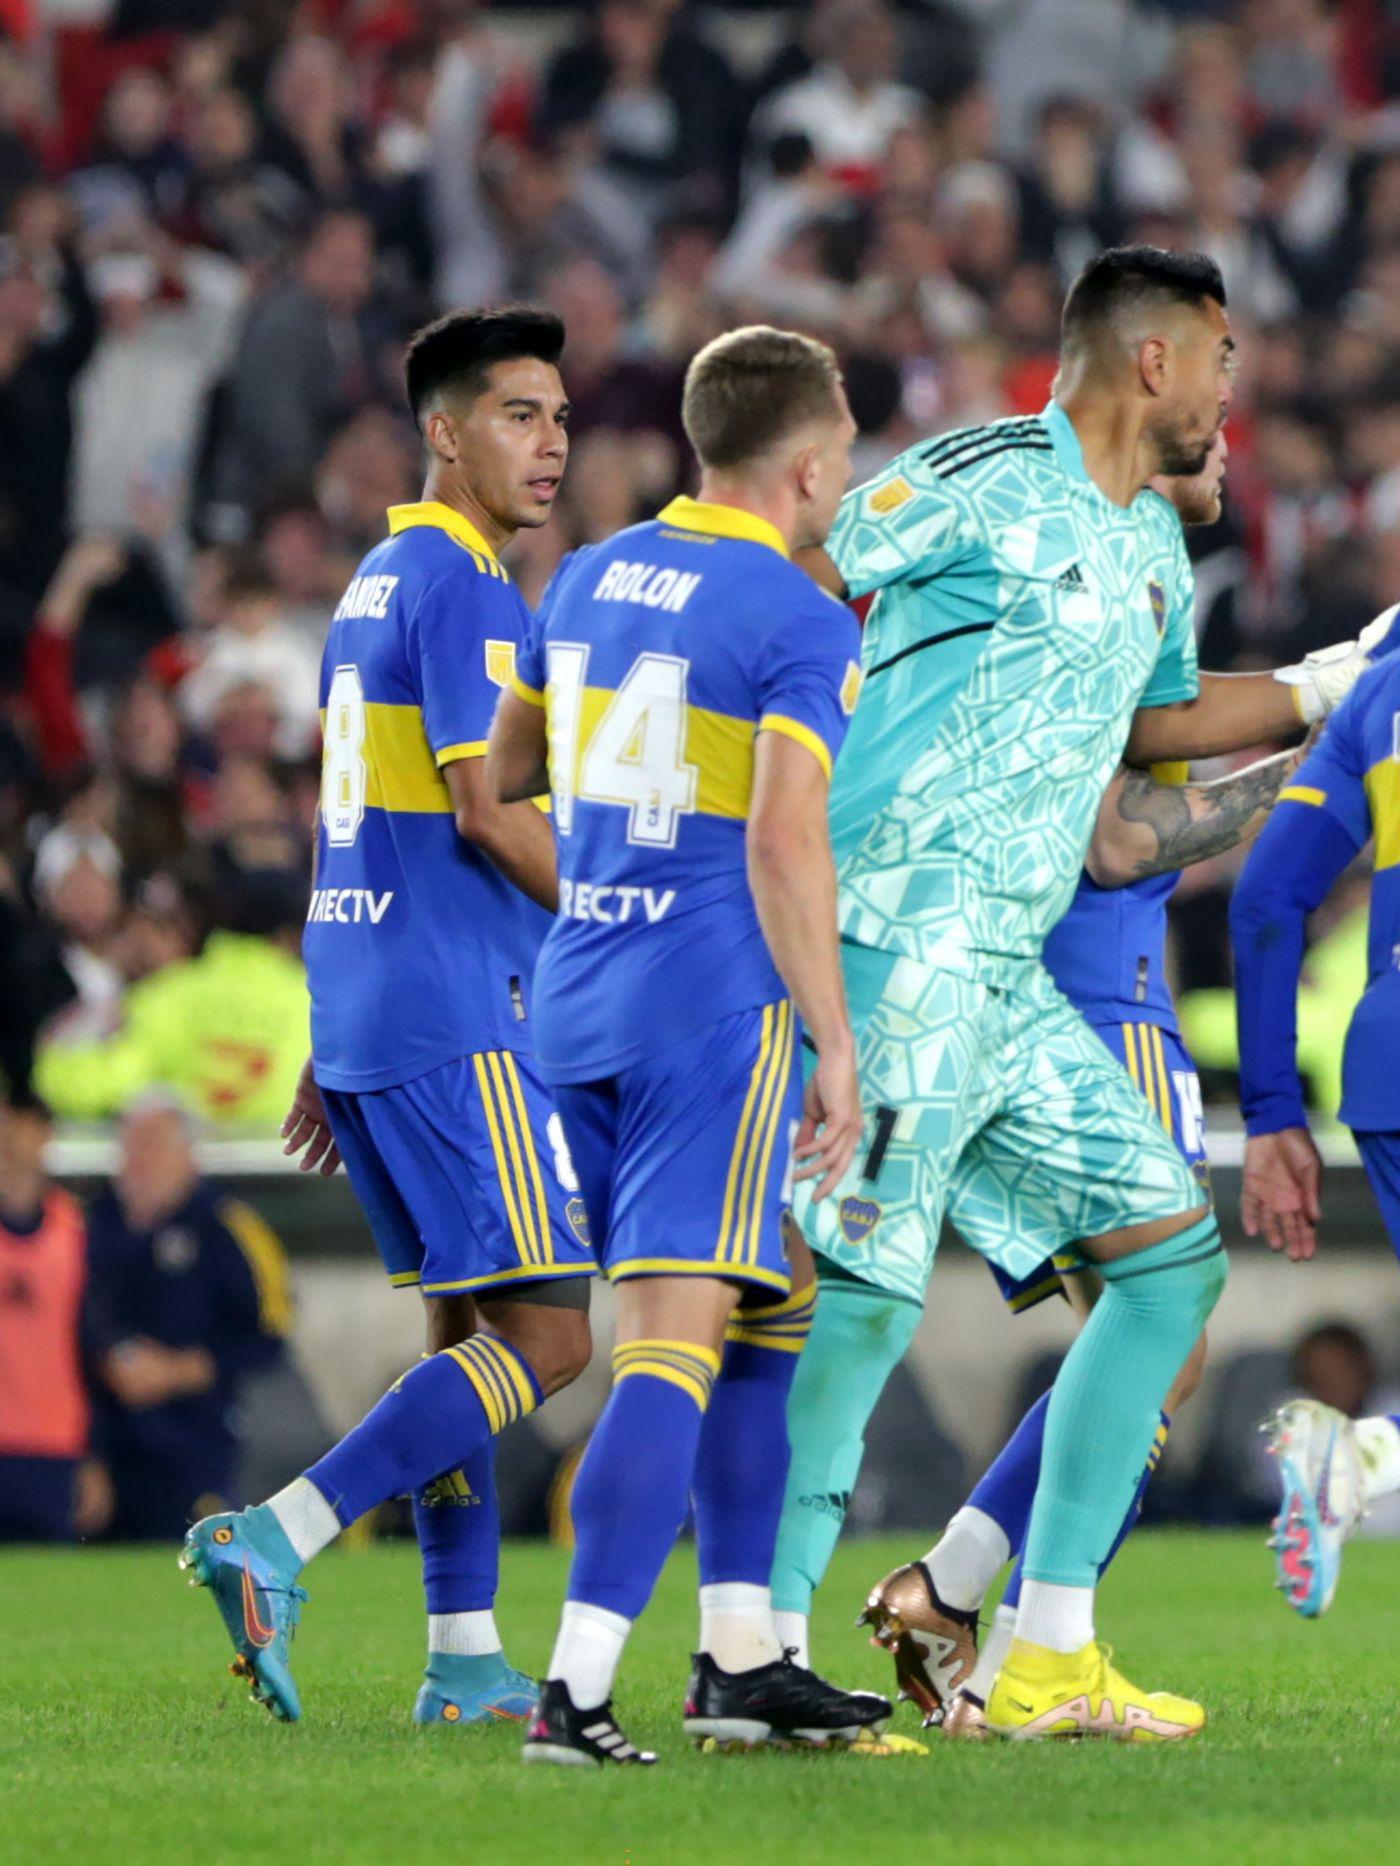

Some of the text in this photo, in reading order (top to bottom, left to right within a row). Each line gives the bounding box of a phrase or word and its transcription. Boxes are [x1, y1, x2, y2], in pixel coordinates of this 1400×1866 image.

[592, 560, 703, 614] ROLON
[322, 664, 367, 847] 8
[545, 641, 698, 849] 14
